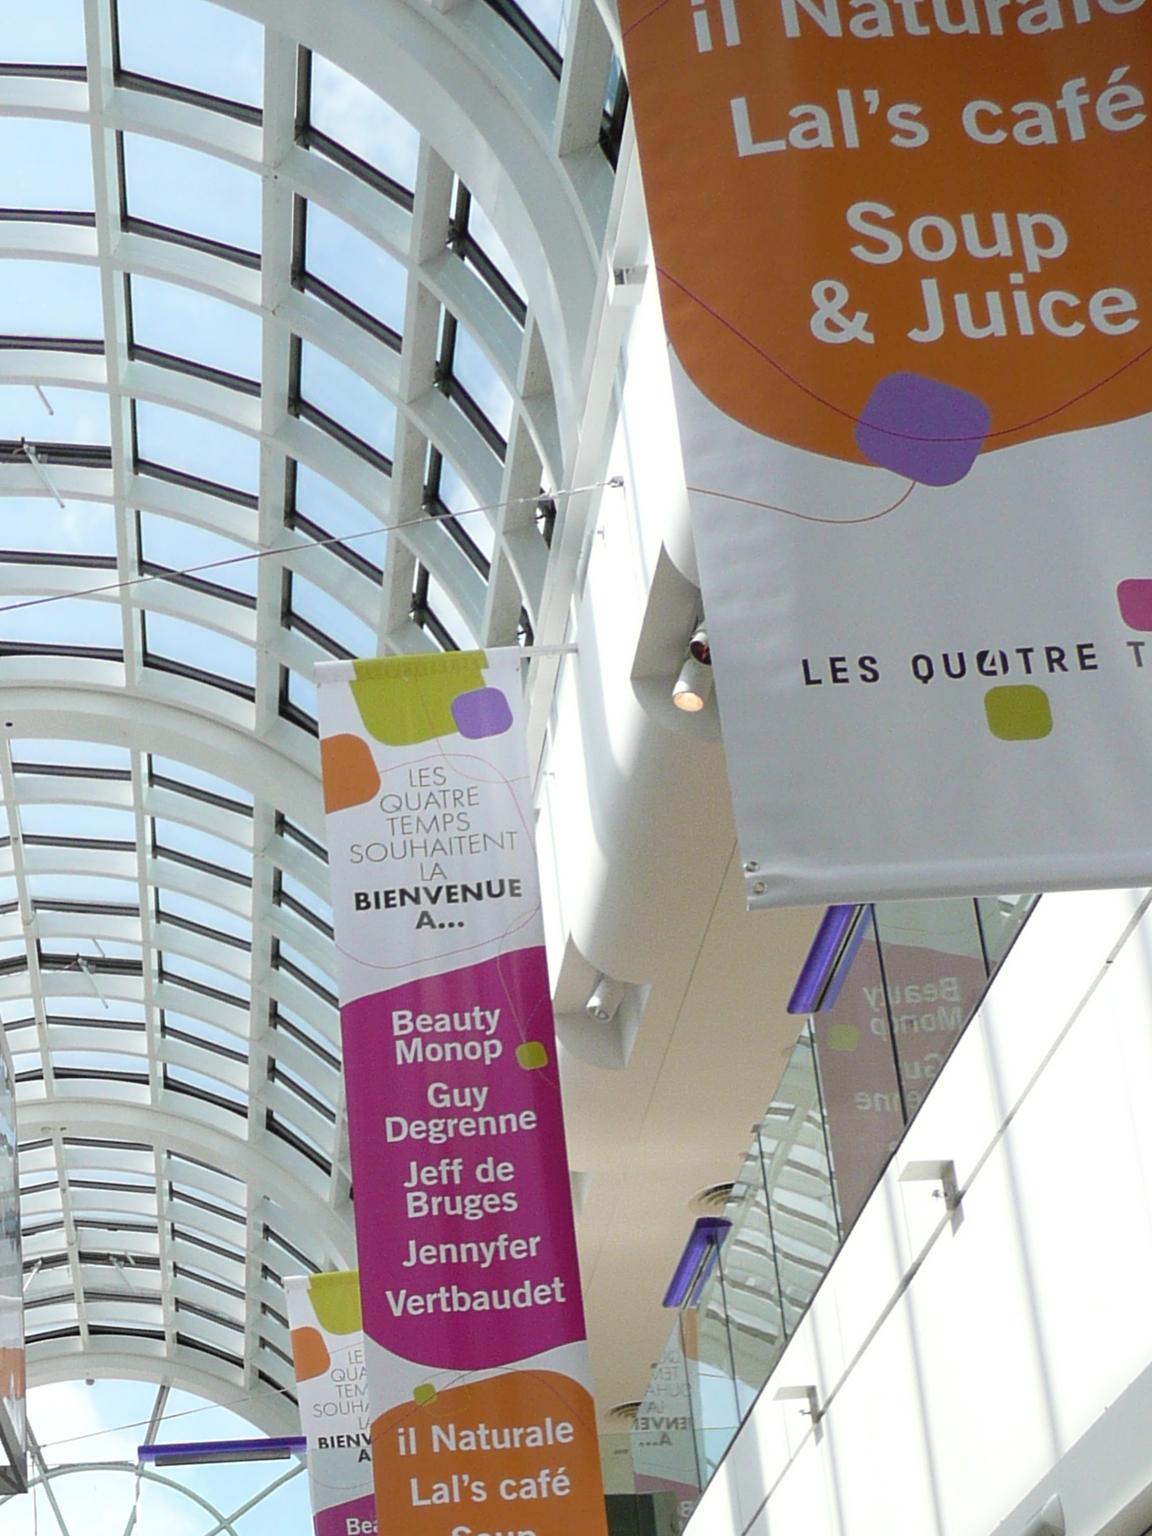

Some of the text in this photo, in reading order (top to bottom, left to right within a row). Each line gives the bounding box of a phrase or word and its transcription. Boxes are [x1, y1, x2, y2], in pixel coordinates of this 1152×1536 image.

[690, 0, 742, 53] il
[730, 66, 1148, 157] Lal's café
[845, 199, 1070, 274] Soup
[809, 269, 1141, 346] & Juice
[802, 654, 882, 687] LES
[409, 766, 448, 788] LES
[379, 786, 481, 815] QUATRE
[386, 812, 472, 836] TEMPS
[349, 830, 519, 864] SOUHAITENT
[419, 860, 448, 882] LA
[354, 877, 523, 912] BIENVENUE
[415, 907, 465, 931] A...
[392, 1005, 502, 1037] Beauty
[395, 1036, 504, 1067] Monop
[426, 1082, 490, 1114] Guy
[384, 1106, 538, 1147] Degrenne
[403, 1156, 515, 1191] Jeff de
[405, 1187, 519, 1221] Bruges
[402, 1233, 541, 1269] Jennyfer
[386, 1276, 566, 1318] Vertbaudet
[397, 1417, 575, 1456] il Naturale
[410, 1466, 572, 1507] Lal's café
